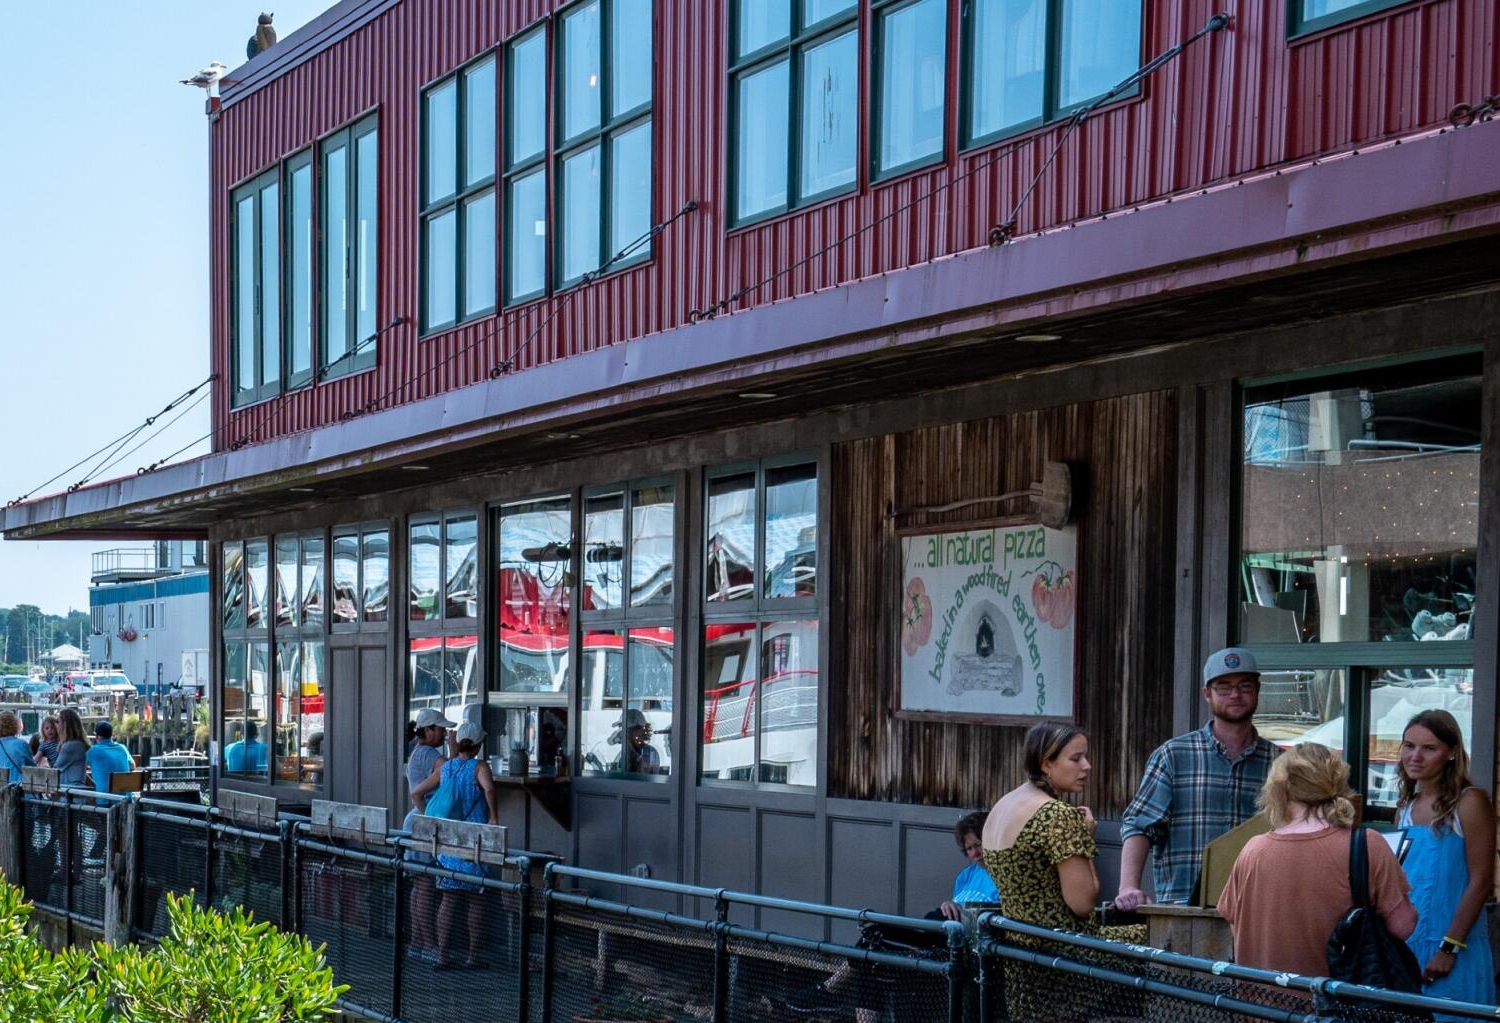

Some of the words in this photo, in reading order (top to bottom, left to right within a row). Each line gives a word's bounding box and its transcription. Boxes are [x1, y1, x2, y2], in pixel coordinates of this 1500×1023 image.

[946, 528, 995, 566] natural
[1003, 527, 1045, 570] pizza
[928, 614, 953, 683] baked
[946, 605, 958, 624] in
[954, 589, 964, 609] a
[962, 564, 986, 595] wood
[986, 564, 1012, 598] fired
[1012, 594, 1041, 670] earthen
[1035, 672, 1046, 715] ove
